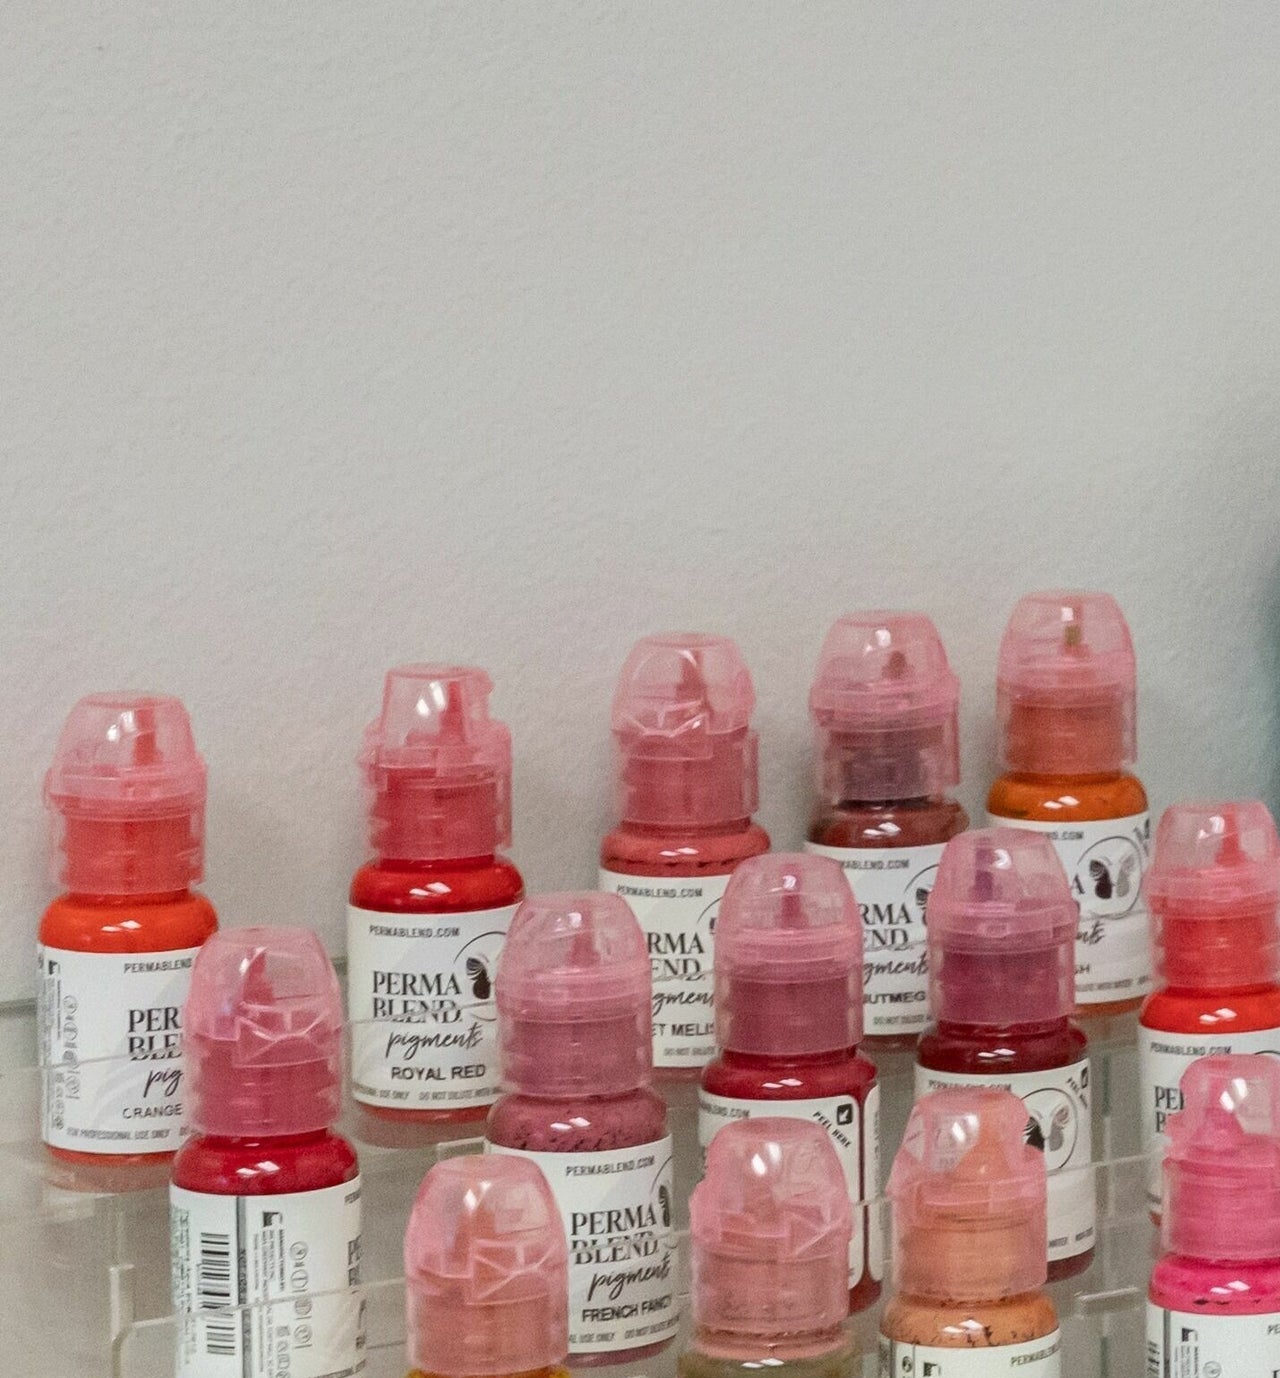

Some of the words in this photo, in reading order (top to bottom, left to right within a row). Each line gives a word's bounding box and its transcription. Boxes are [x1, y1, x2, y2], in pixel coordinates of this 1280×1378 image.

[861, 902, 913, 926] RMA
[369, 925, 461, 938] PERMABLEND.COM
[647, 932, 705, 955] RMA
[124, 957, 193, 974] PERMABLEND
[372, 970, 462, 996] PERMA
[128, 1006, 182, 1033] PER
[128, 1033, 184, 1061] BLE
[385, 1021, 484, 1061] pigments
[391, 1066, 446, 1081] ROYAL
[451, 1064, 487, 1079] RED
[570, 1202, 658, 1236] PERMA
[587, 1251, 672, 1302] pigment
[582, 1303, 639, 1322] FRENCH
[641, 1295, 672, 1316] FANC
